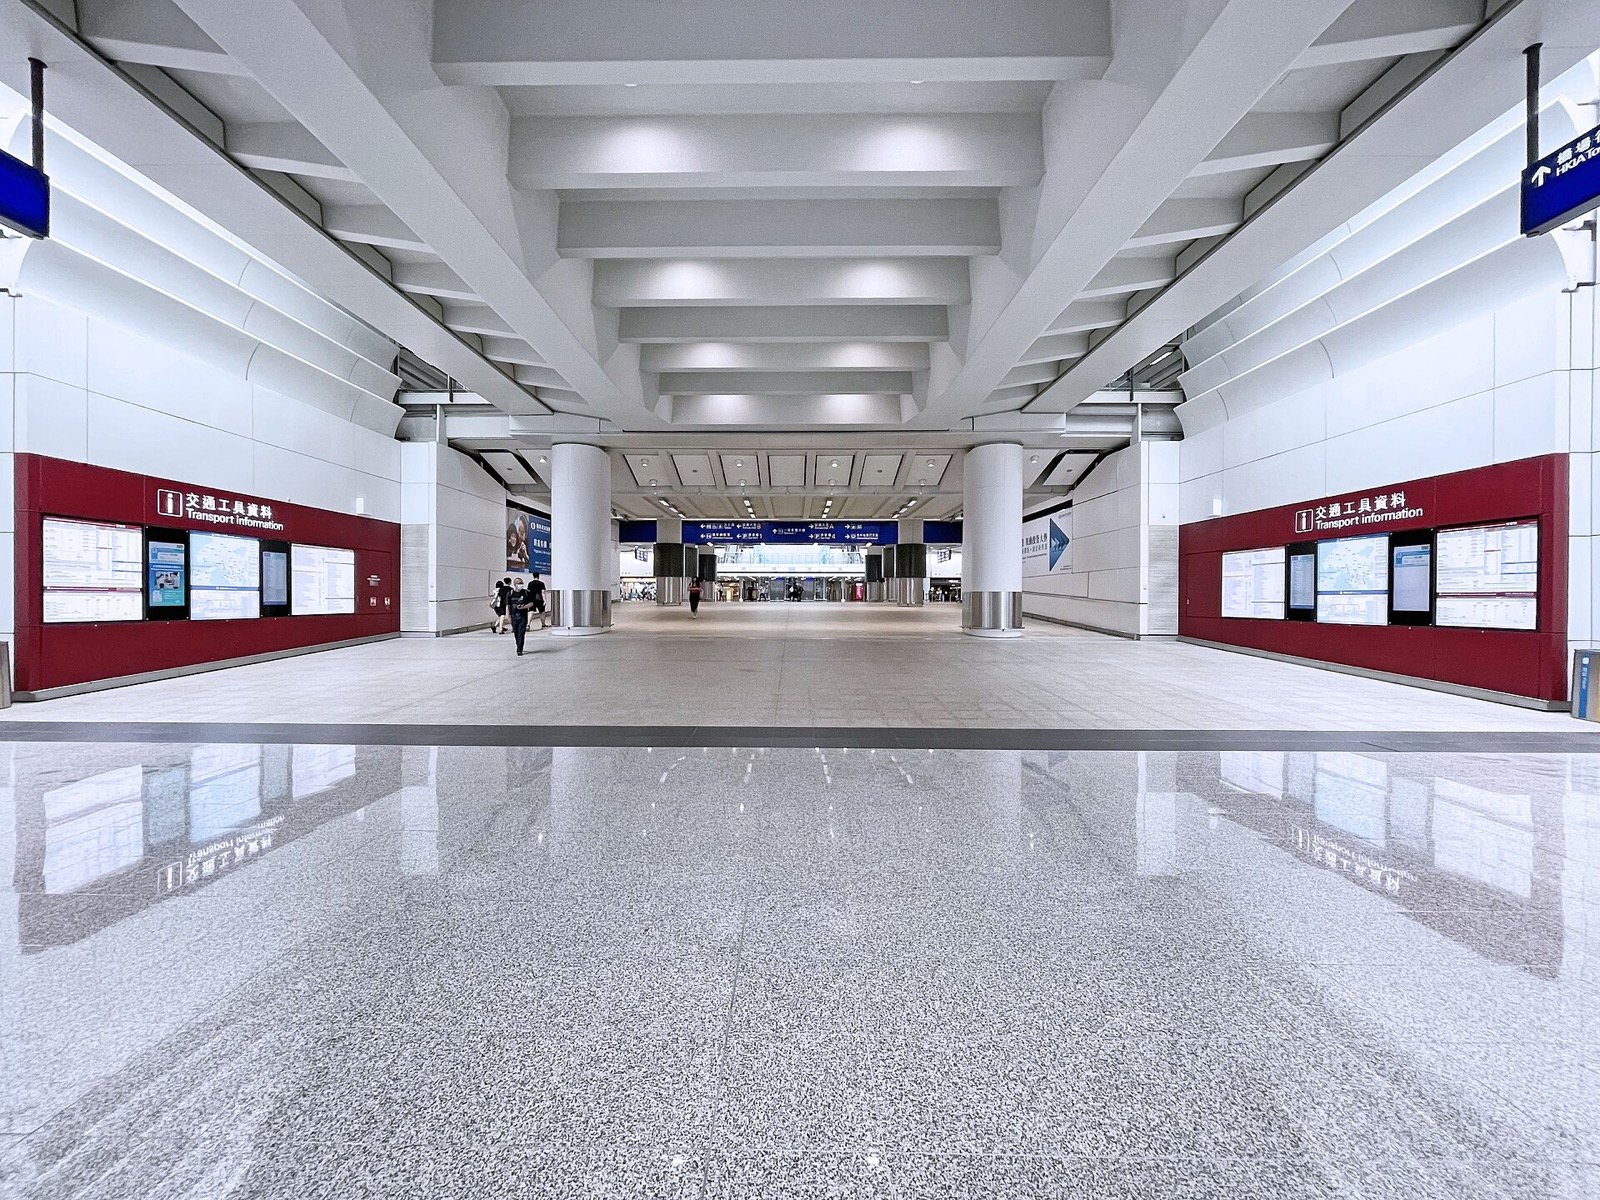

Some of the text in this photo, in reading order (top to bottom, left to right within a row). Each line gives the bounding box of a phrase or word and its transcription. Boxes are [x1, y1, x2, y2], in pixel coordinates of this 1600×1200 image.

[1556, 146, 1600, 177] HKIA To
[185, 492, 272, 519] 交通工具資料
[185, 507, 284, 531] Transport information
[1315, 491, 1406, 520] 交通工具資料
[1315, 507, 1423, 530] Transport information
